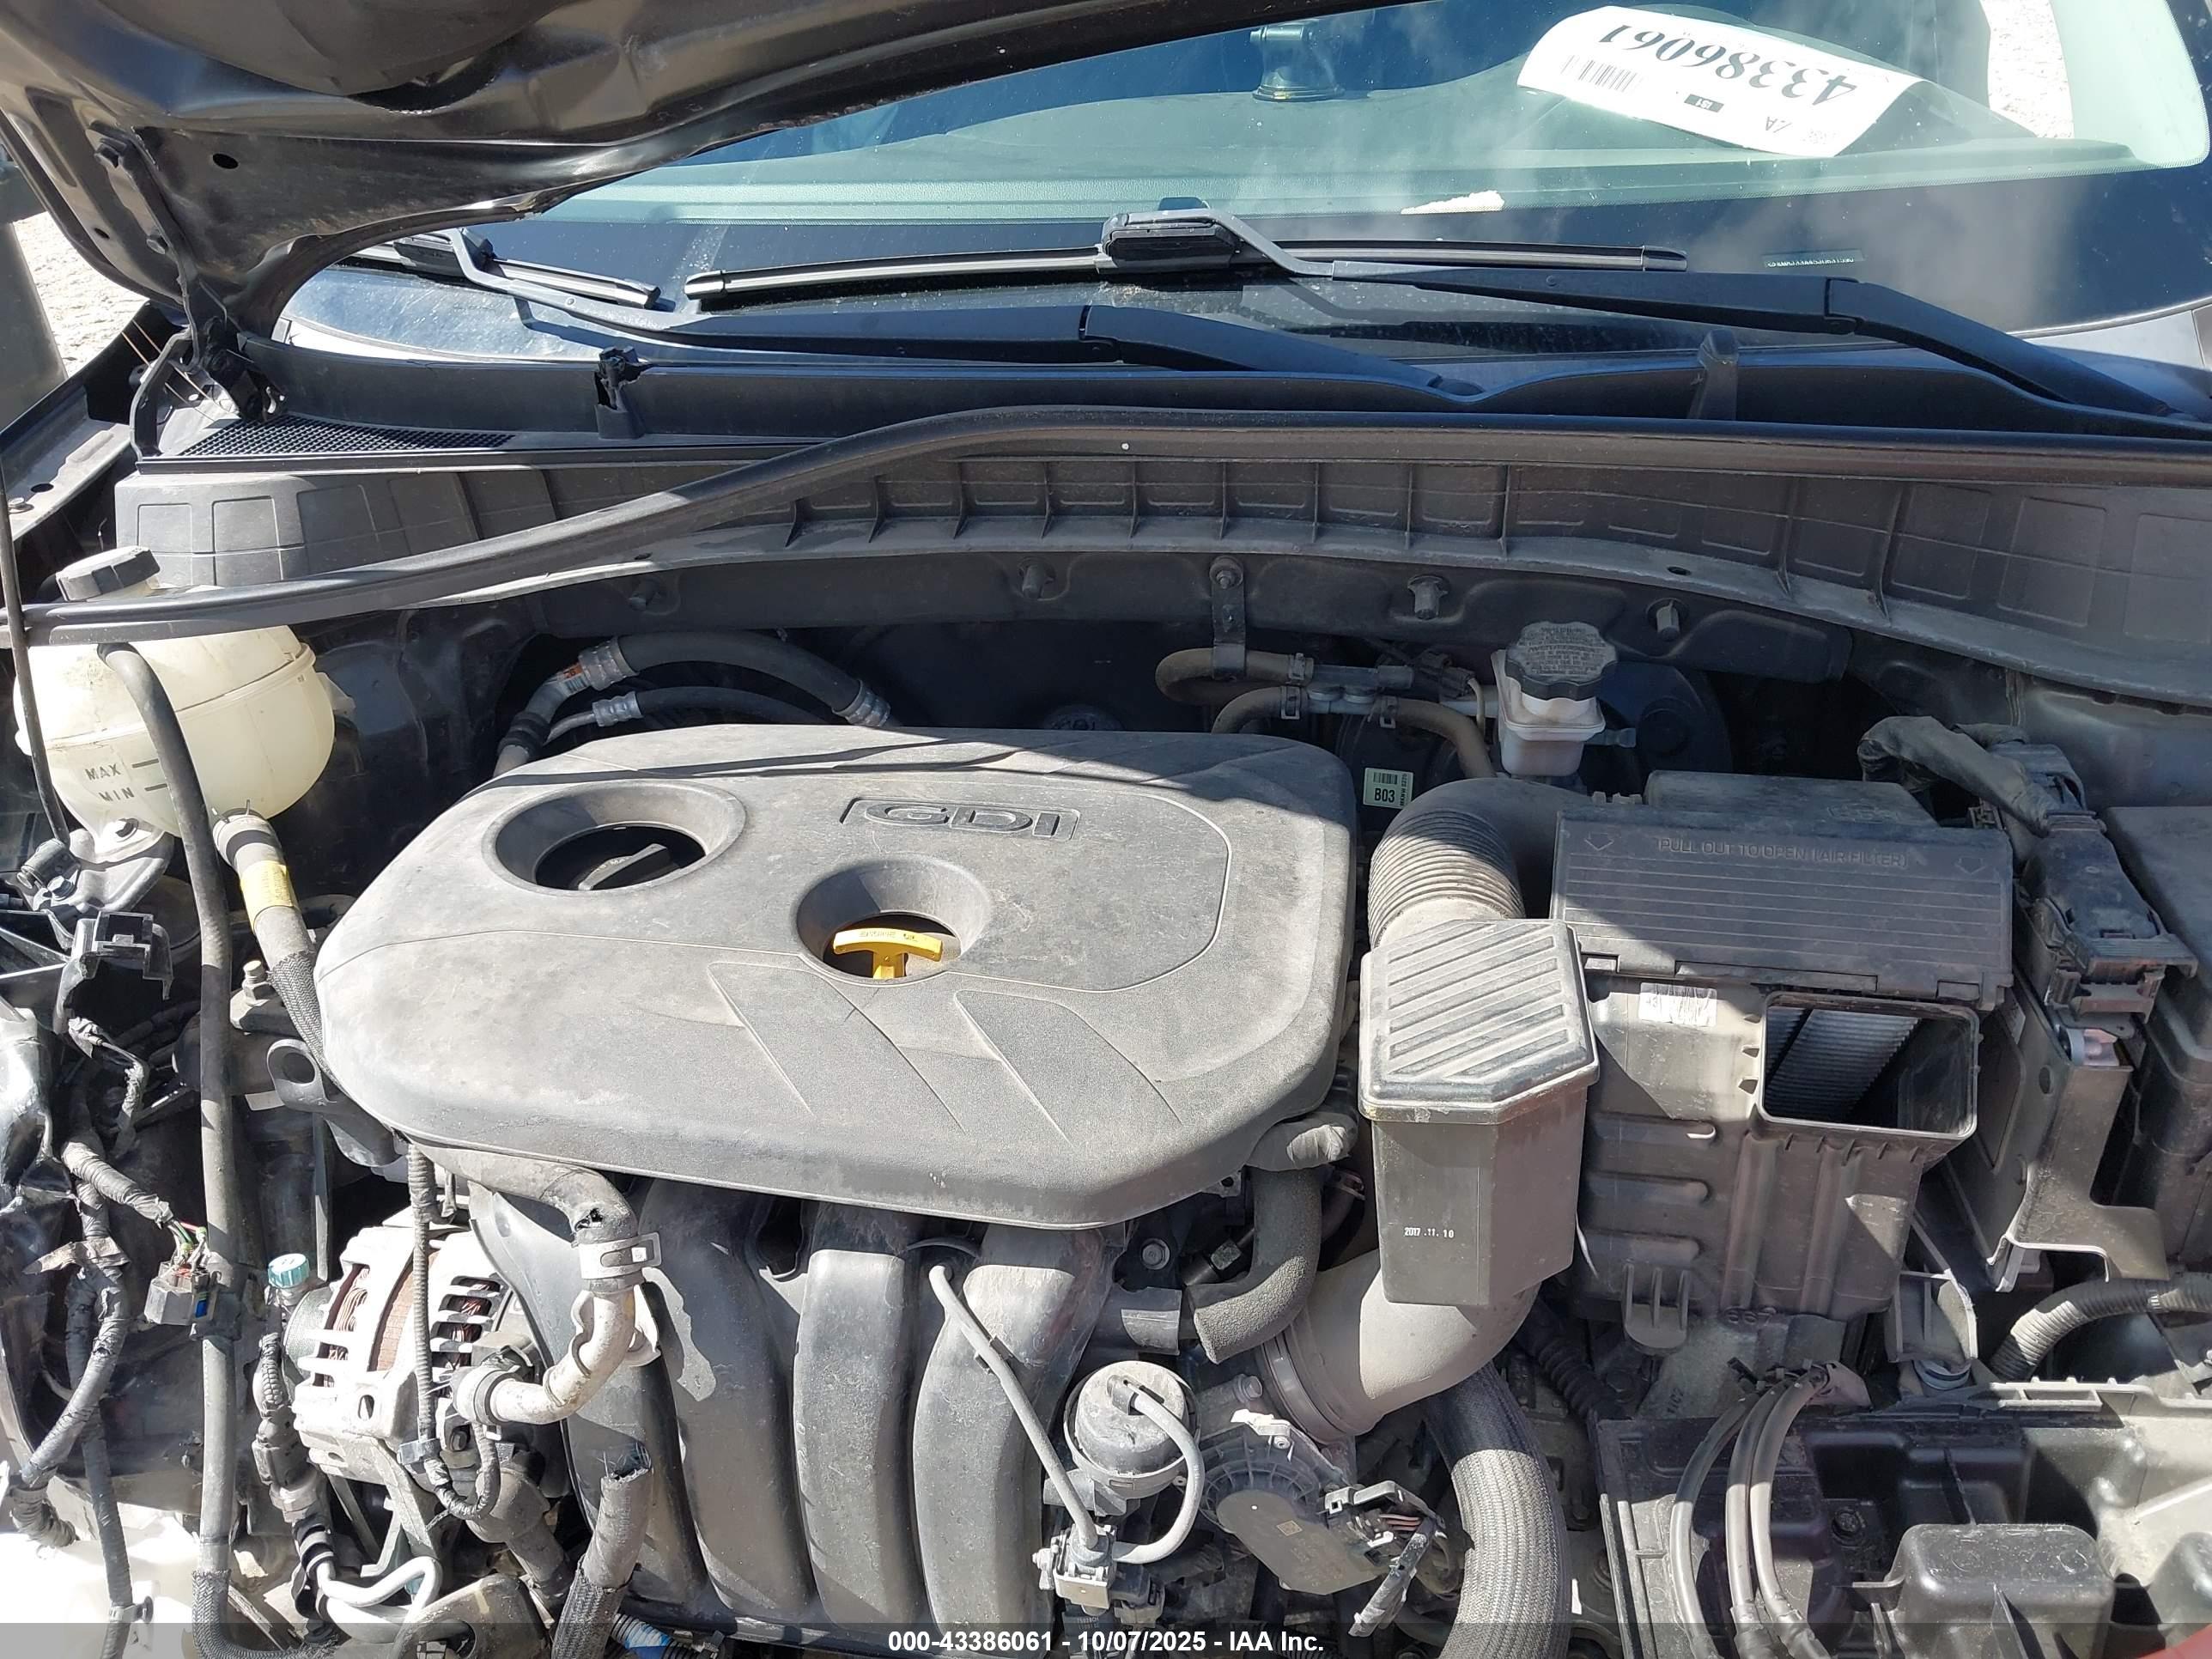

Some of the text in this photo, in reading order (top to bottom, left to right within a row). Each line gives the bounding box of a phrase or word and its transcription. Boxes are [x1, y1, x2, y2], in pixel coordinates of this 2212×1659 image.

[1598, 24, 1857, 106] 43386061
[84, 763, 121, 781] MAX
[98, 787, 135, 802] MIN
[1375, 787, 1395, 803] B03
[865, 803, 1061, 837] GDI
[1657, 837, 1698, 853] PULL
[1702, 841, 1732, 855] OUT
[1738, 844, 1759, 858] TO
[1760, 844, 1807, 860] OPEN
[1403, 1227, 1421, 1237] 2017
[1443, 1229, 1455, 1238] 10
